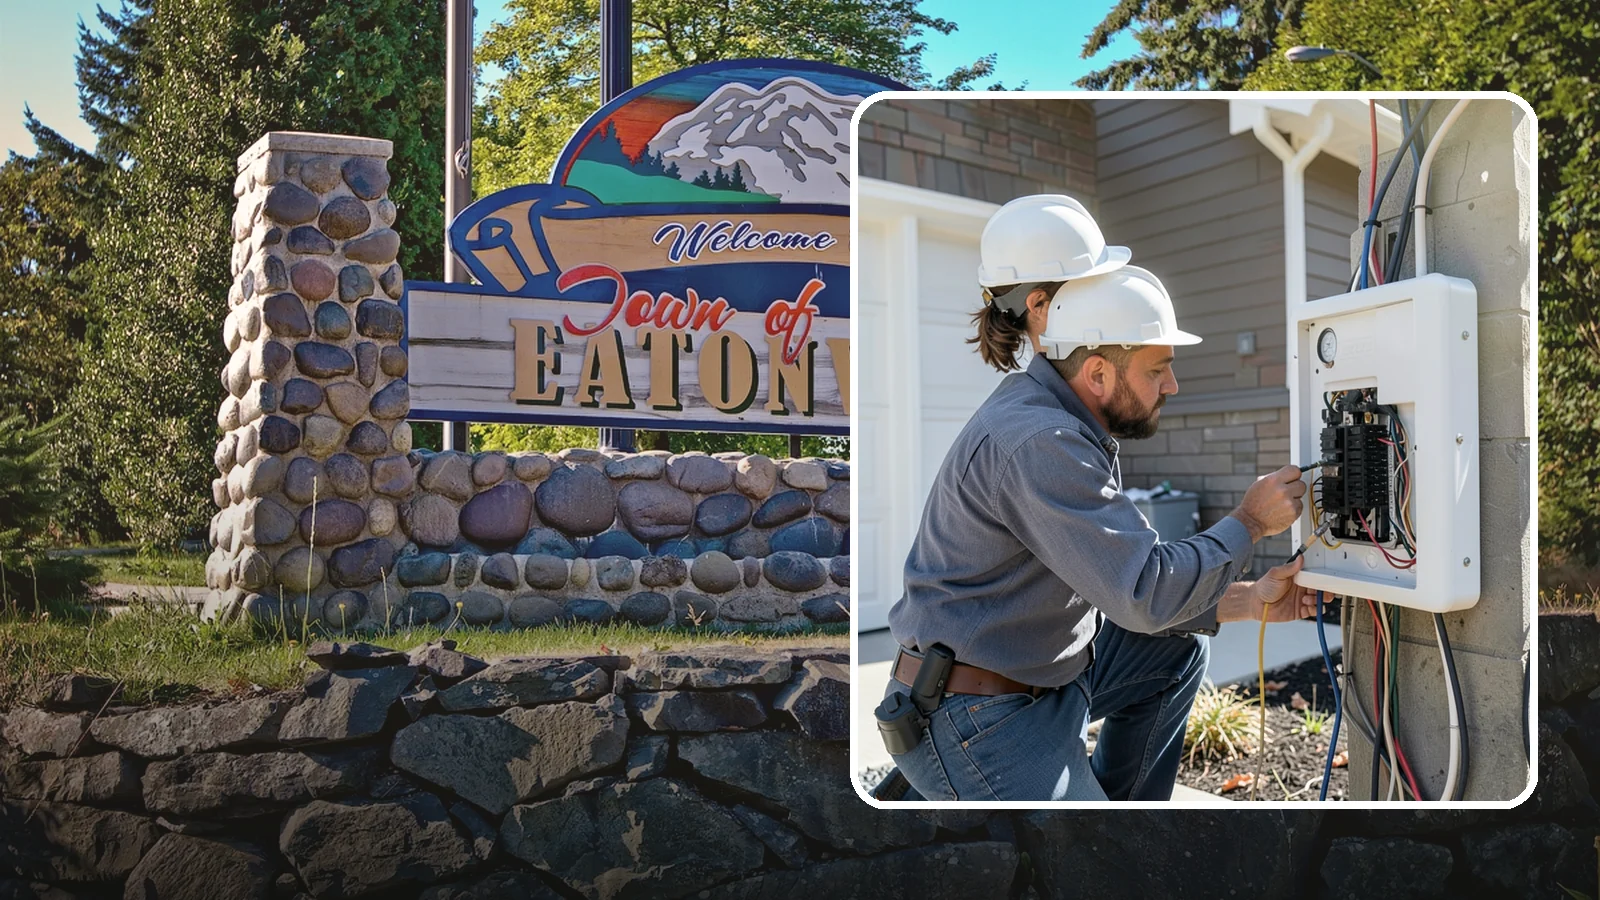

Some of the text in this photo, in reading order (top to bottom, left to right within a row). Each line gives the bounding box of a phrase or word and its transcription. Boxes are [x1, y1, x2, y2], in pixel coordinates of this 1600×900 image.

[653, 221, 836, 262] Welcome
[557, 264, 825, 364] Town of
